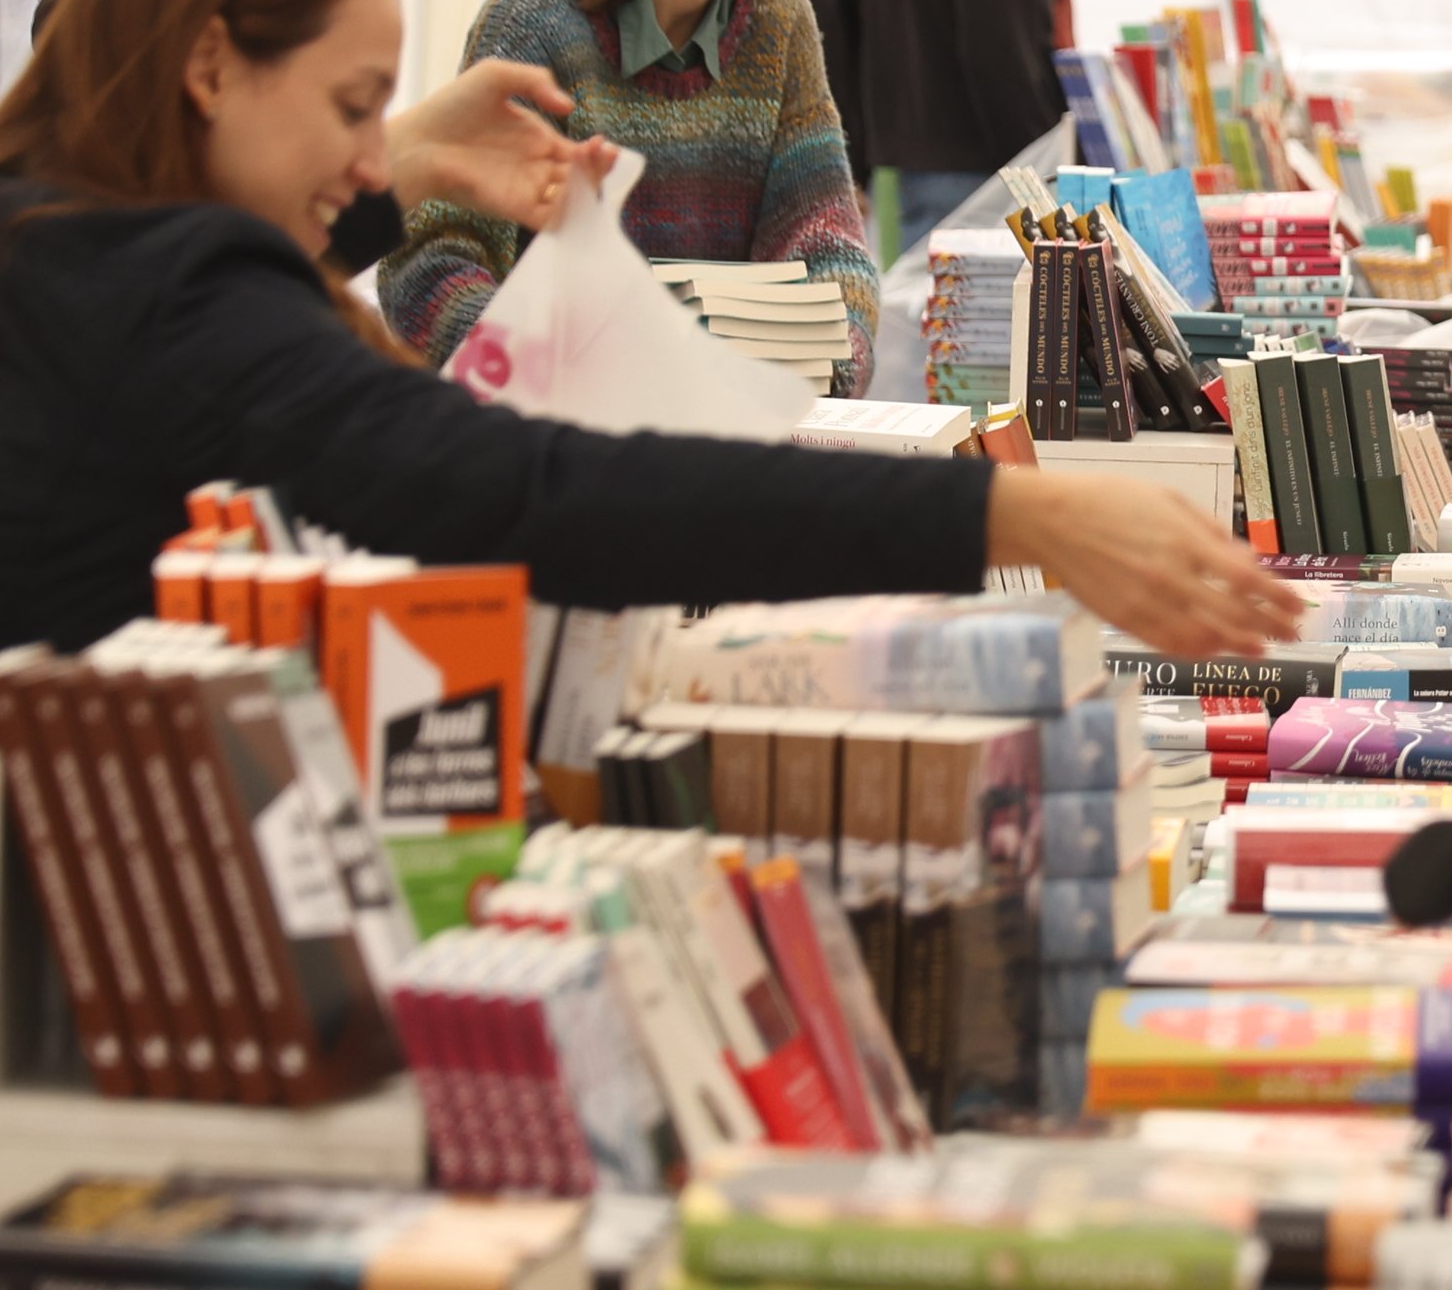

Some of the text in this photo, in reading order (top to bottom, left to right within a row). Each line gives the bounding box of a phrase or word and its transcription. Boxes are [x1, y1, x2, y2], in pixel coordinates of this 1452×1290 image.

[1037, 268, 1049, 321] CÓCTELES
[1061, 268, 1072, 321] CÓCTELES
[1090, 270, 1106, 323] CÓCTELES
[1101, 337, 1115, 376] MUNDO
[1142, 318, 1159, 348] TONI
[1036, 335, 1046, 374] MUNDO
[1059, 335, 1070, 374] MUNDO
[790, 433, 819, 446] Molts
[826, 437, 856, 449] ningú
[1331, 449, 1340, 477] INFINIT
[1375, 452, 1384, 477] INFINIT
[1314, 571, 1344, 579] llibretera
[1333, 617, 1398, 630] Allí donde
[1334, 632, 1399, 643] nace el día
[1102, 660, 1282, 685] URO LÍNEA DE
[1193, 683, 1281, 705] FUEGO
[1348, 686, 1392, 699] FERNÁNDEZ
